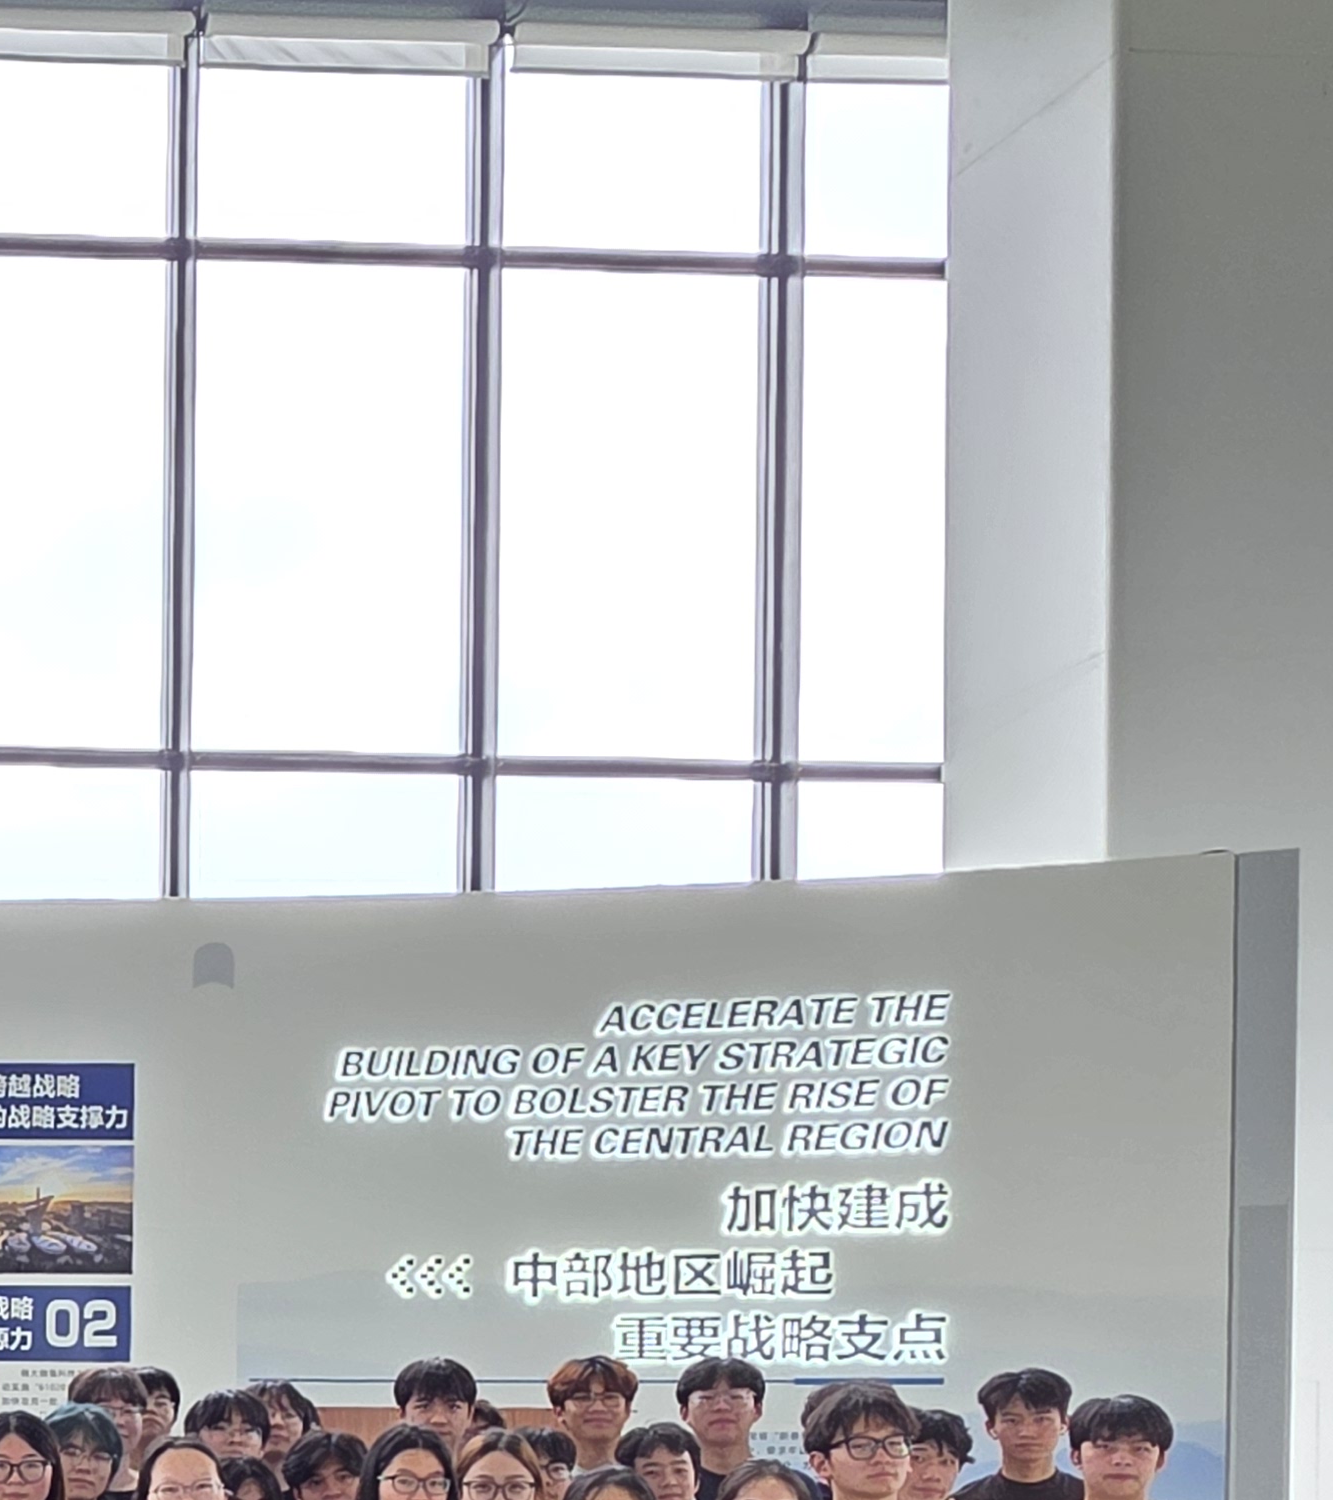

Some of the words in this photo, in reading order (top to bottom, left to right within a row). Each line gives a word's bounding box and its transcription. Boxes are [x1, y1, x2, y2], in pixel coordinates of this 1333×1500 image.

[599, 997, 858, 1032] ACCELERATE
[871, 993, 951, 1024] THE
[340, 1047, 521, 1078] BUILDING
[531, 1046, 586, 1075] OF
[592, 1044, 619, 1074] A
[631, 1042, 712, 1073] KEY
[718, 1036, 950, 1071] STRATEGIC
[328, 1088, 442, 1119] PIVOT
[451, 1088, 502, 1118] TO
[513, 1085, 689, 1116] BOLSTER
[702, 1082, 779, 1113] THE
[788, 1079, 881, 1110] RISE
[891, 1078, 950, 1108] OF
[512, 1128, 584, 1157] THE
[593, 1125, 774, 1156] CENTRAL
[787, 1120, 949, 1152] REGION
[726, 1182, 950, 1233] 加快建成
[512, 1247, 835, 1299] 中部地区崛起
[45, 1299, 118, 1348] 02
[614, 1312, 948, 1362] 重要战略支点
